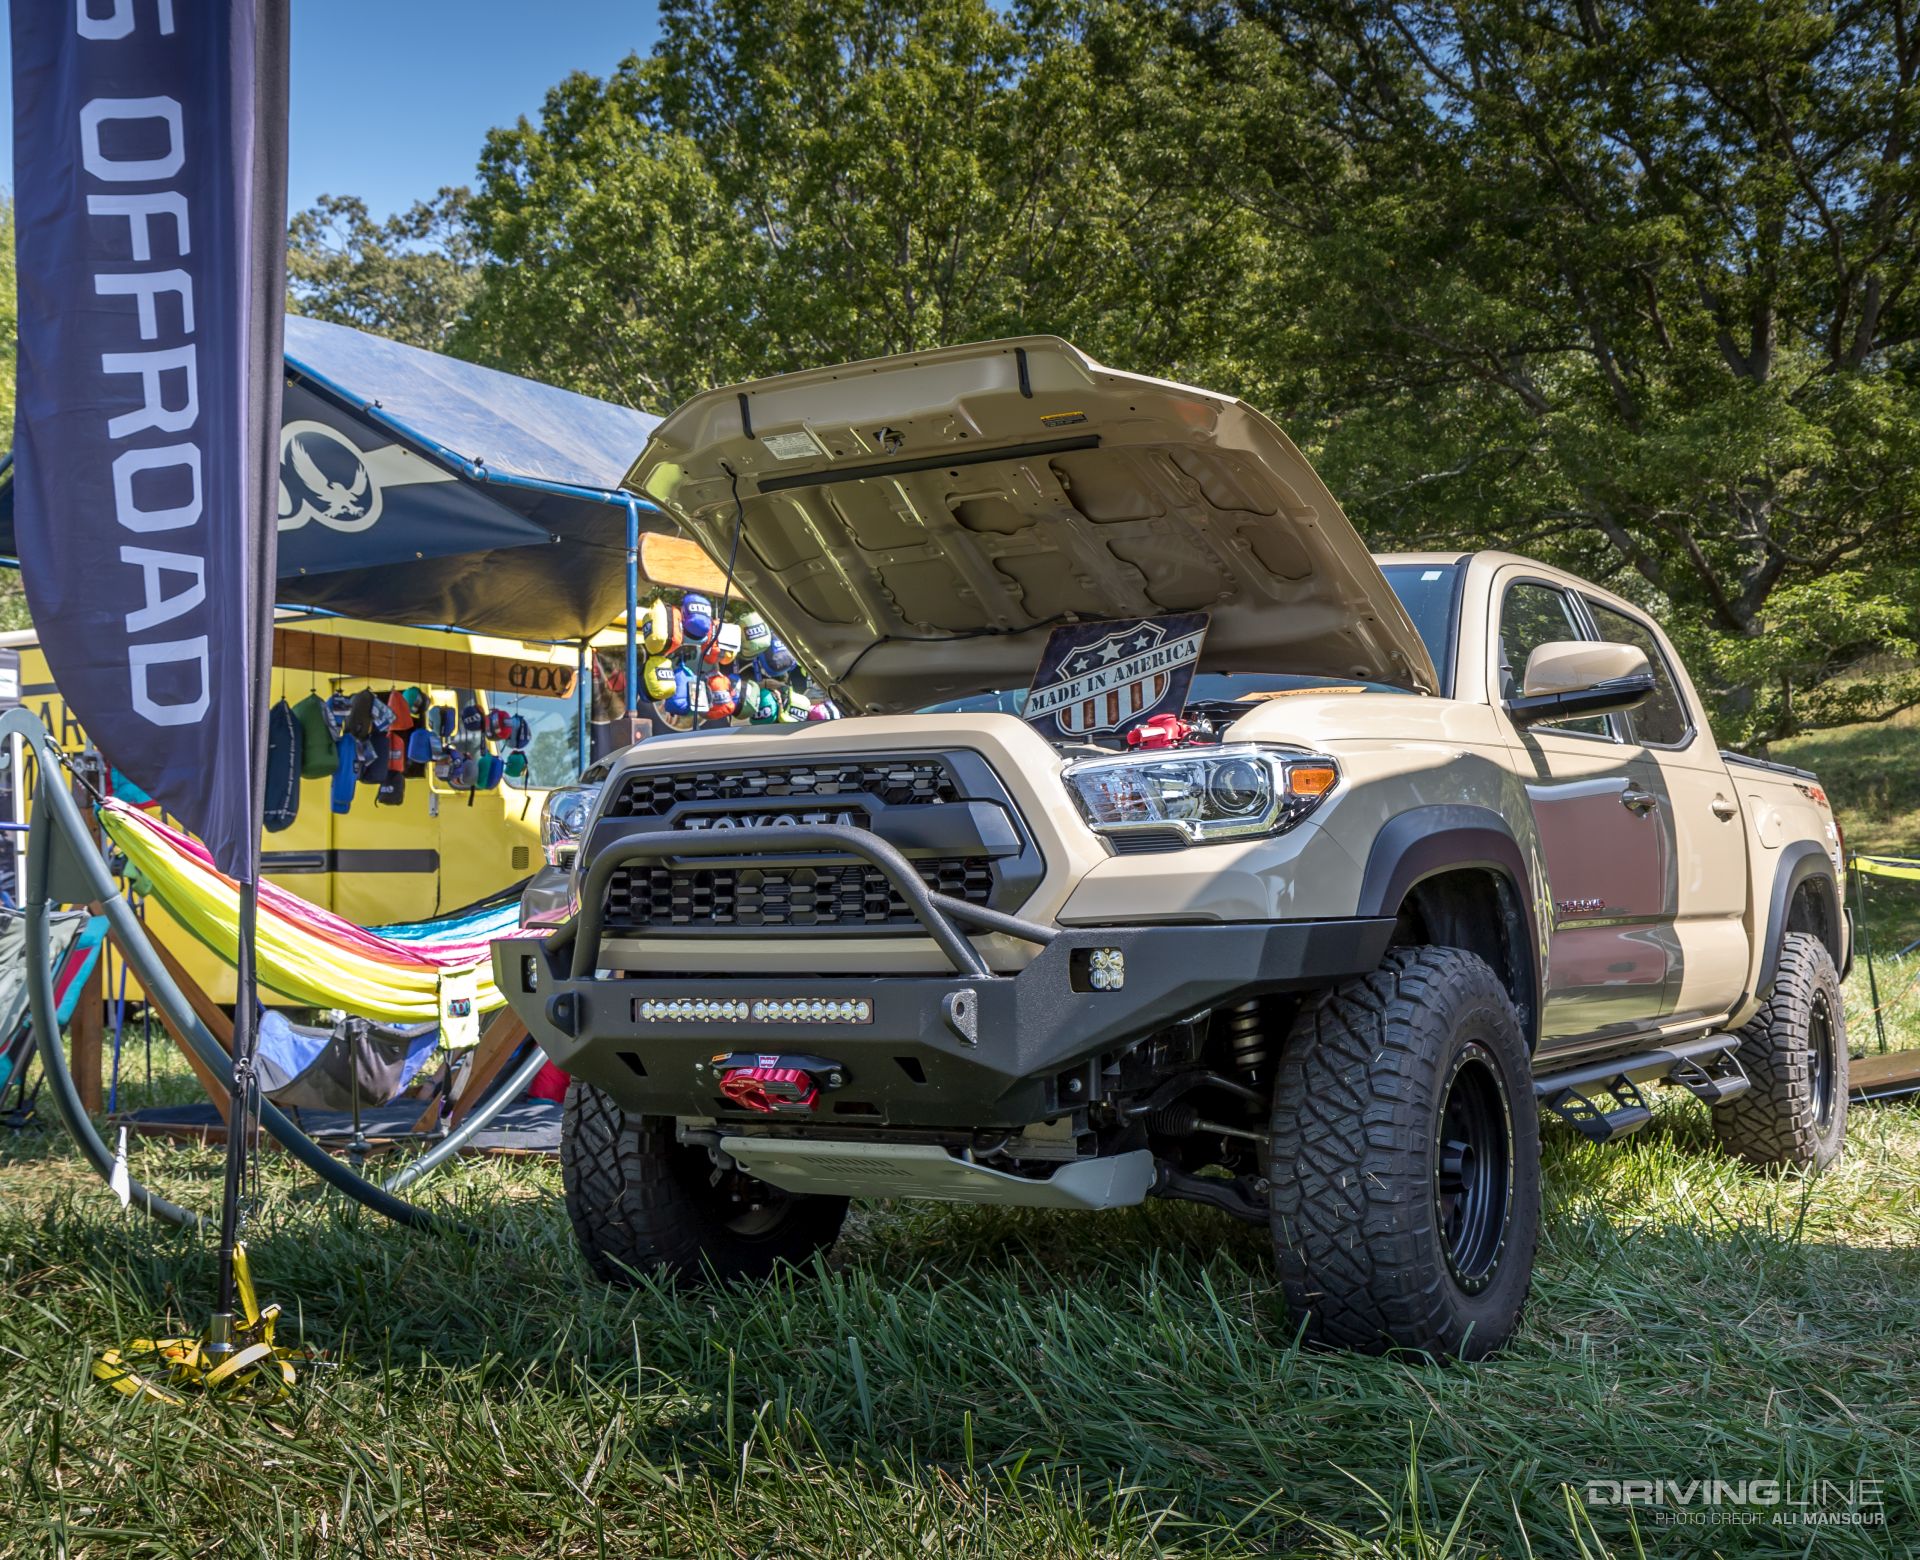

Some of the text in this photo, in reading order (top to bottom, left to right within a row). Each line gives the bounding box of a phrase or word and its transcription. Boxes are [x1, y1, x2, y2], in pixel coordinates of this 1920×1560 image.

[79, 95, 211, 727] OFFROAD
[1031, 640, 1197, 712] MADE IN AMERICA
